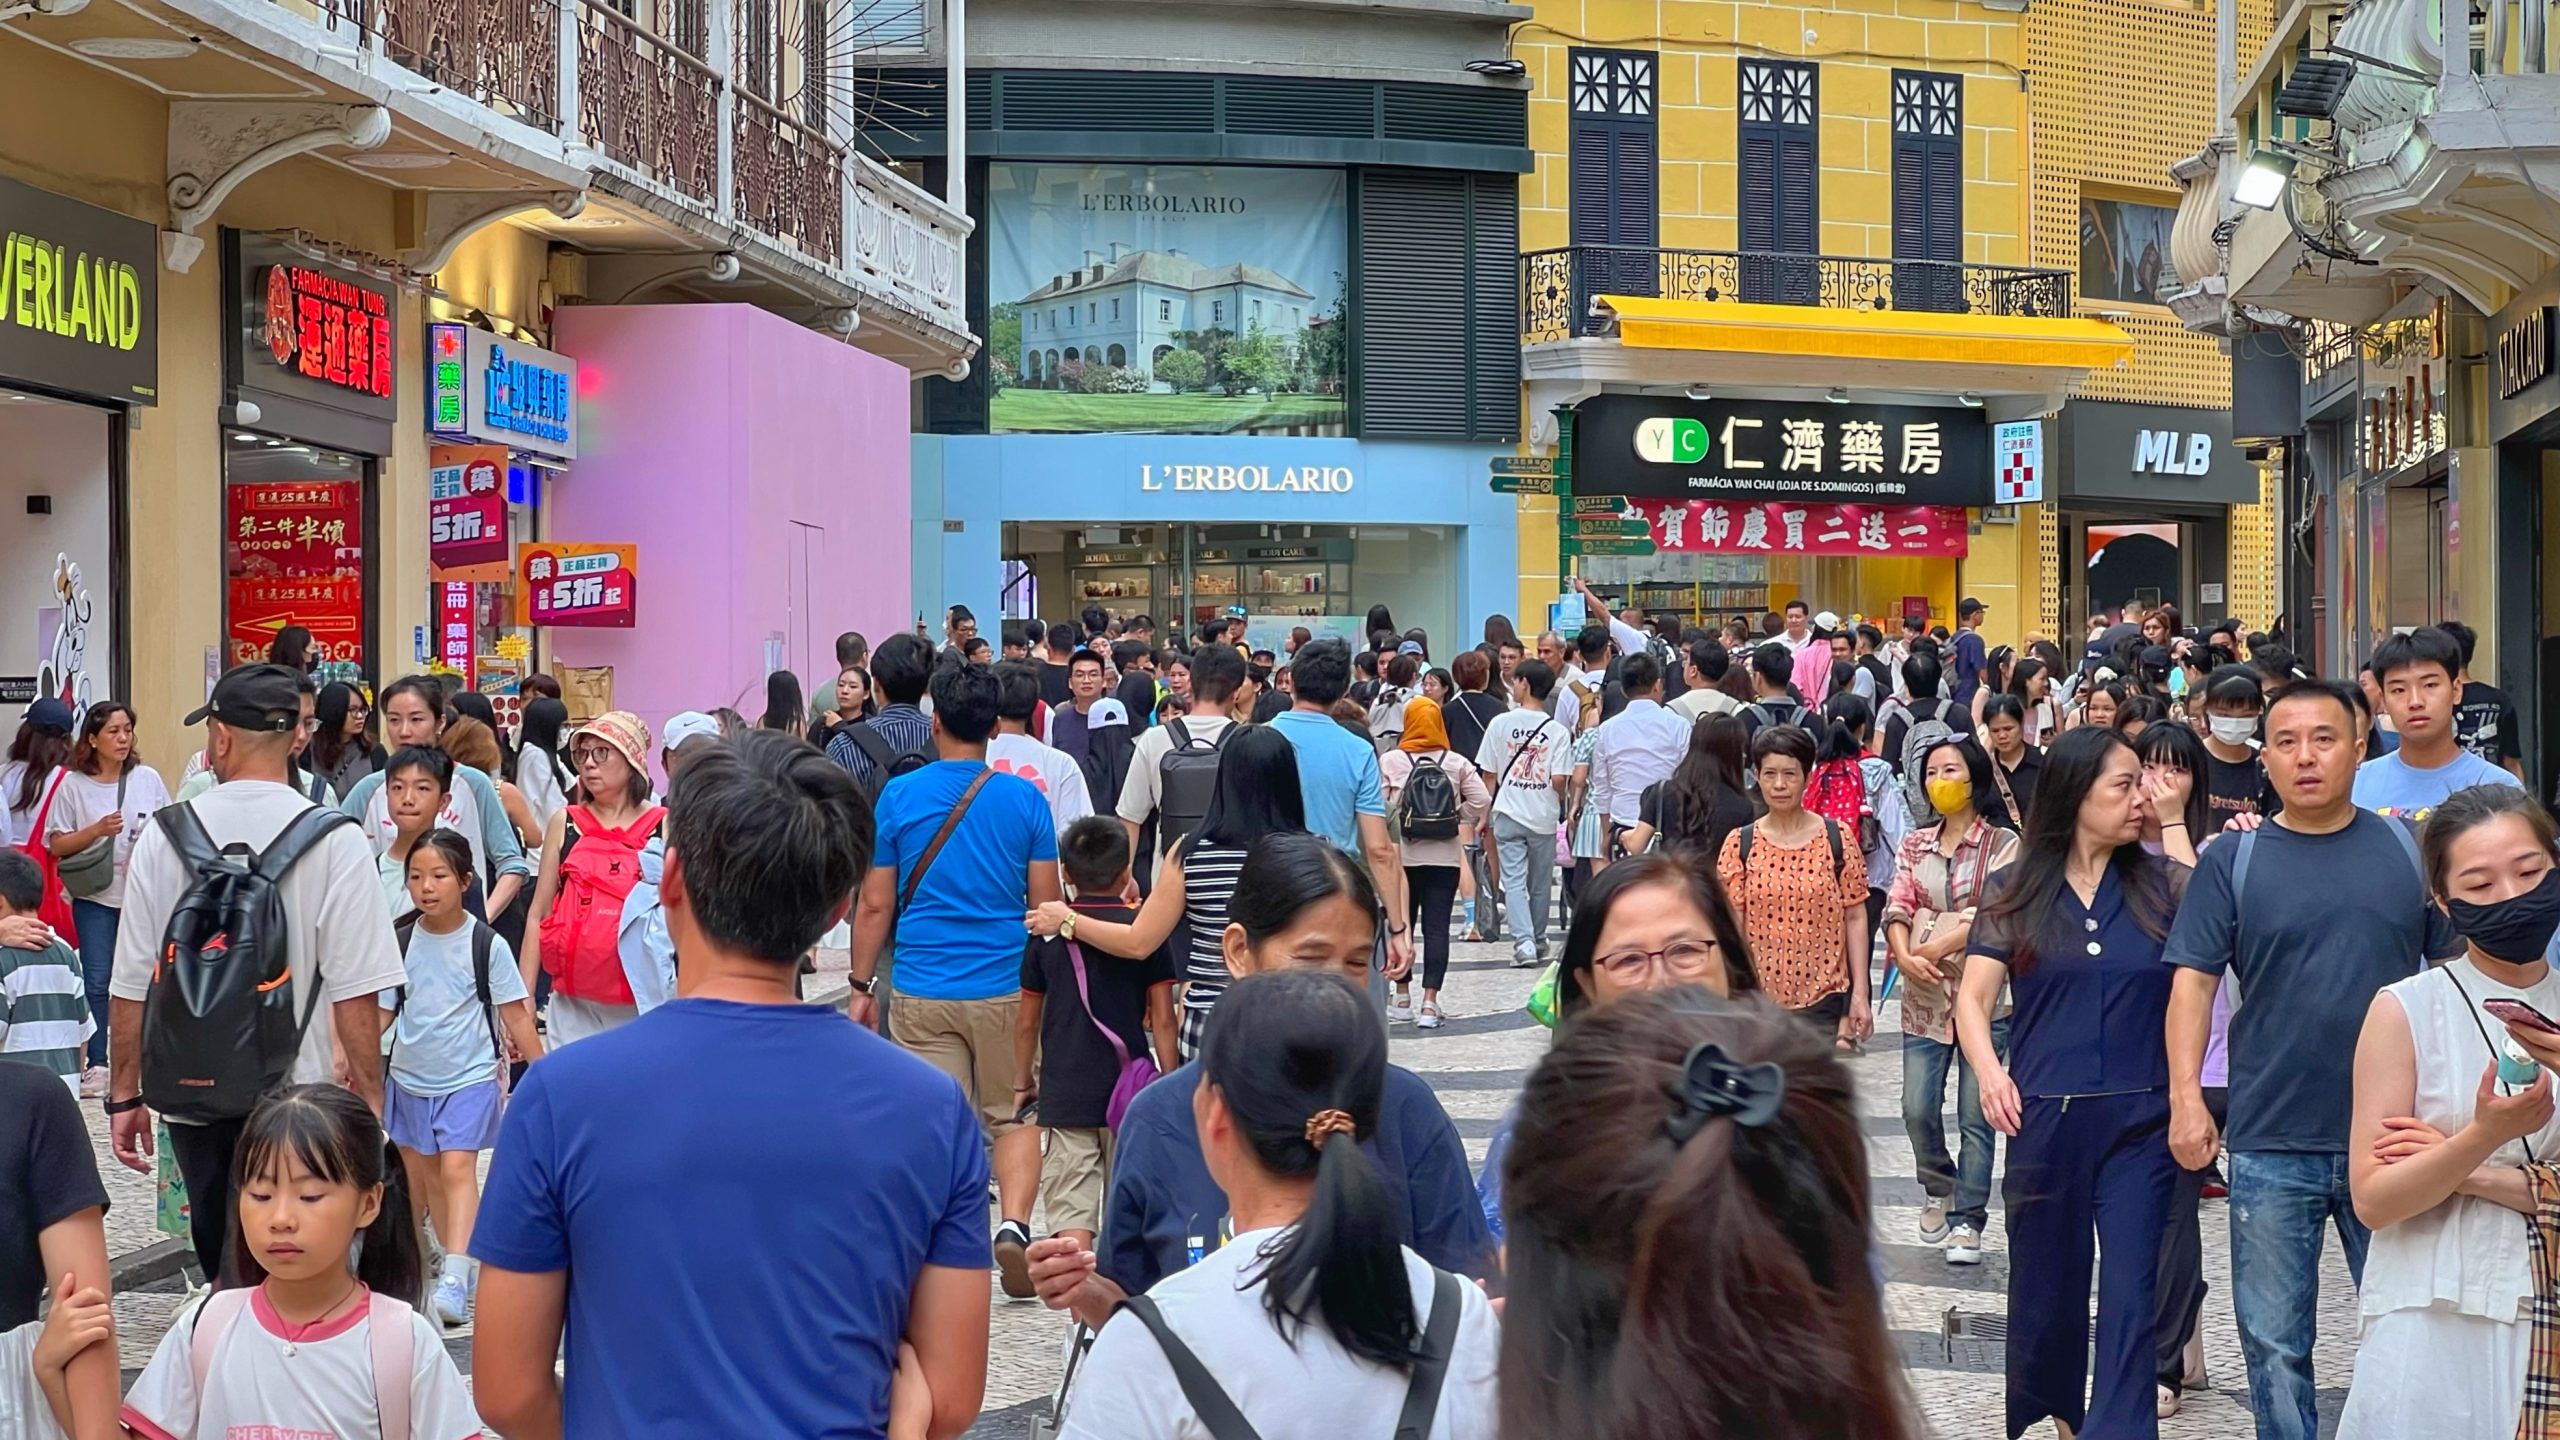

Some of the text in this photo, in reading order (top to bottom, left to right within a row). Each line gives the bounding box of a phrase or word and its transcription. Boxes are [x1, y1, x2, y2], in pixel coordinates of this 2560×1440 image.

[1083, 194, 1246, 214] L'ERBOLARIO
[338, 281, 359, 308] WAN
[361, 289, 385, 316] TUNG
[2499, 306, 2544, 400] STACCATO
[437, 360, 461, 424] 藥房
[1719, 416, 1942, 474] 仁濟藥房
[2132, 429, 2212, 475] MLB
[1141, 464, 1354, 493] L'ERBOLARIO
[1688, 476, 1733, 488] FARMÁCIA
[1734, 479, 1752, 489] YAN
[1753, 479, 1775, 490] CHAI
[1801, 481, 1812, 490] DE
